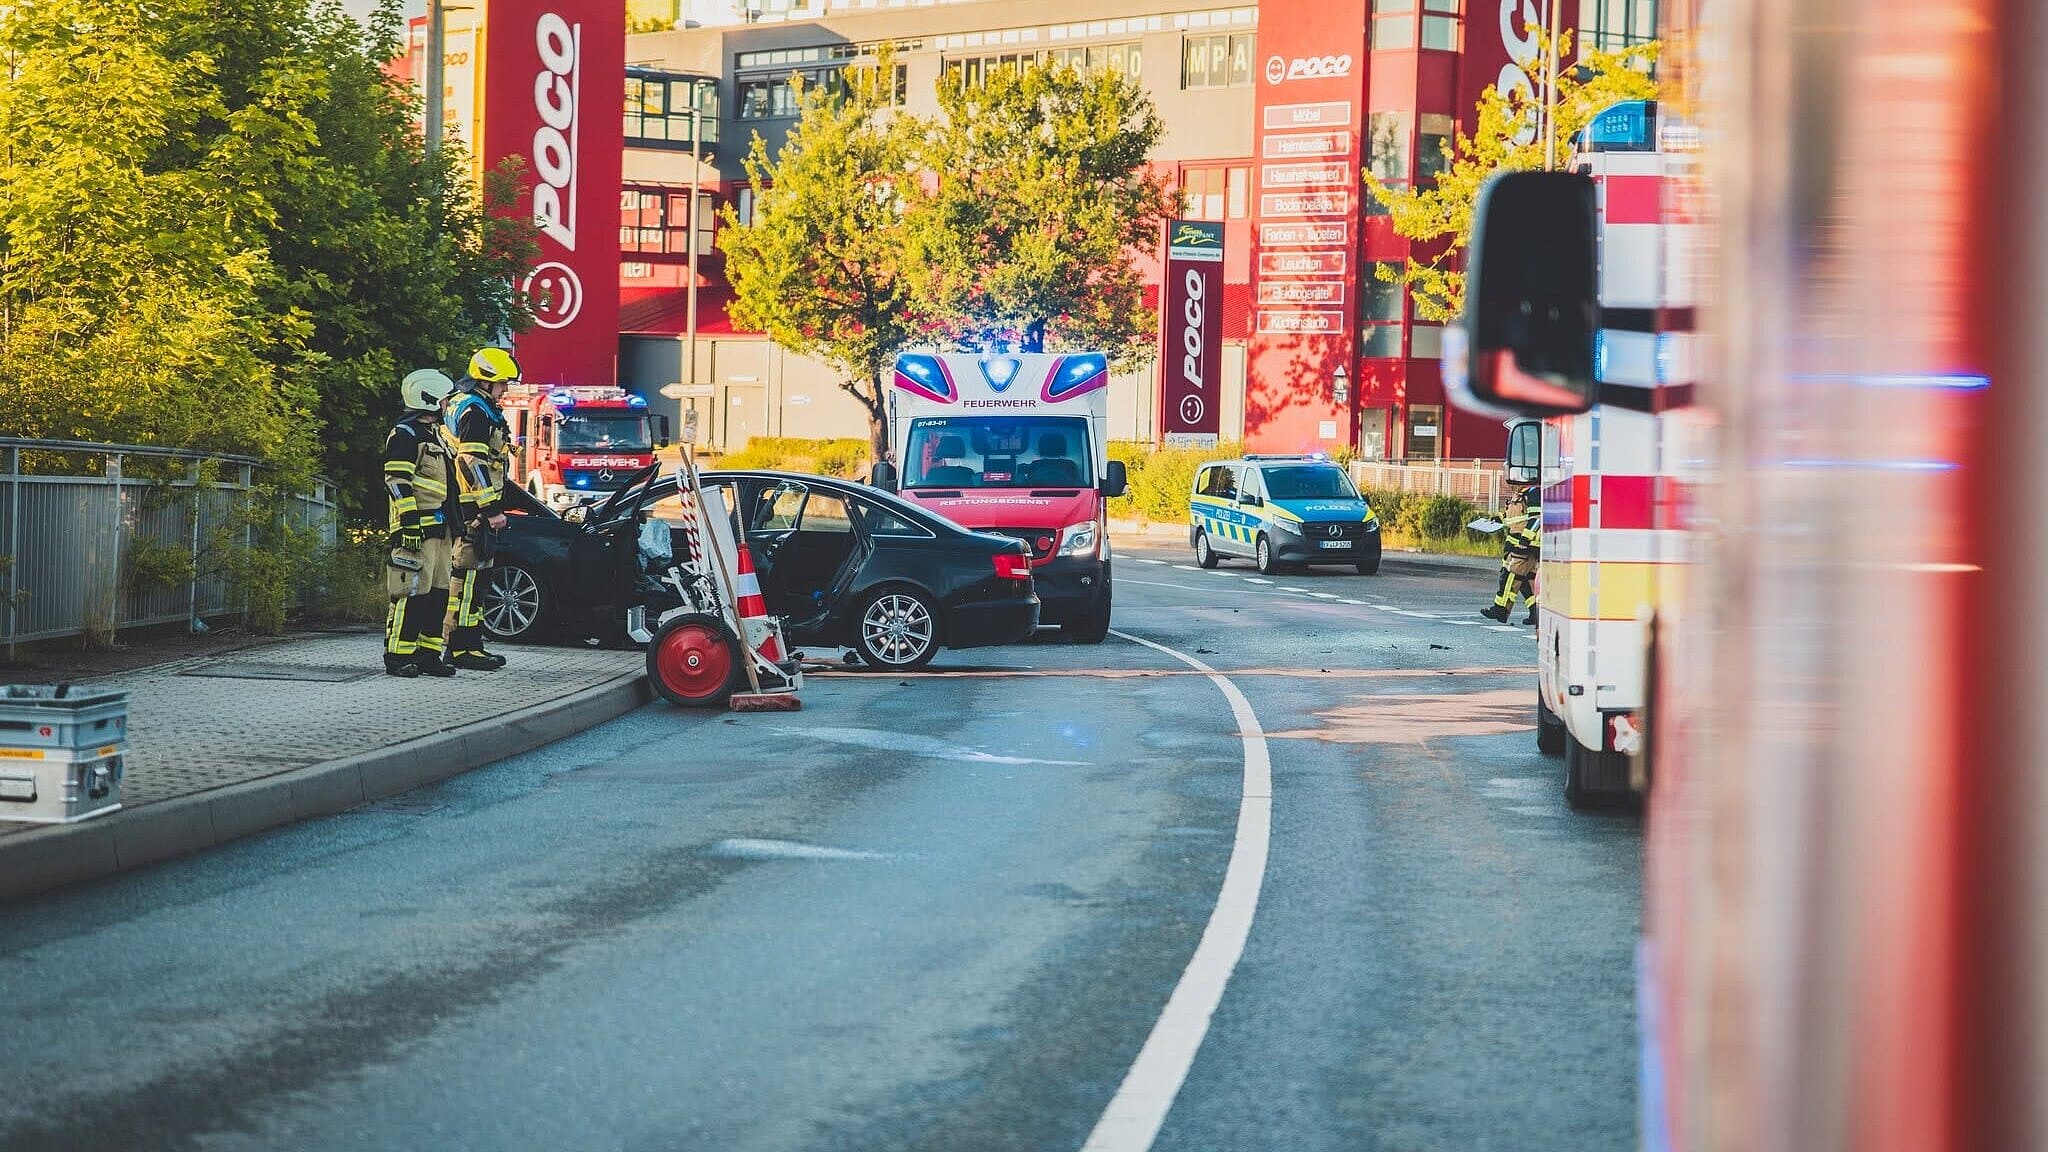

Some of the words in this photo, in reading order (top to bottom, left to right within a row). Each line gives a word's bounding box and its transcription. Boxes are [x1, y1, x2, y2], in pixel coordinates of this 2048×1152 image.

[442, 52, 468, 66] OCO
[1286, 54, 1353, 80] POCO
[533, 12, 581, 252] POCO
[1183, 269, 1206, 389] POCO
[963, 399, 1037, 408] FEUERWEHR
[571, 458, 640, 467] FEUERWEHR
[1304, 503, 1352, 511] POLIZEI
[1215, 508, 1231, 521] POLIZEI
